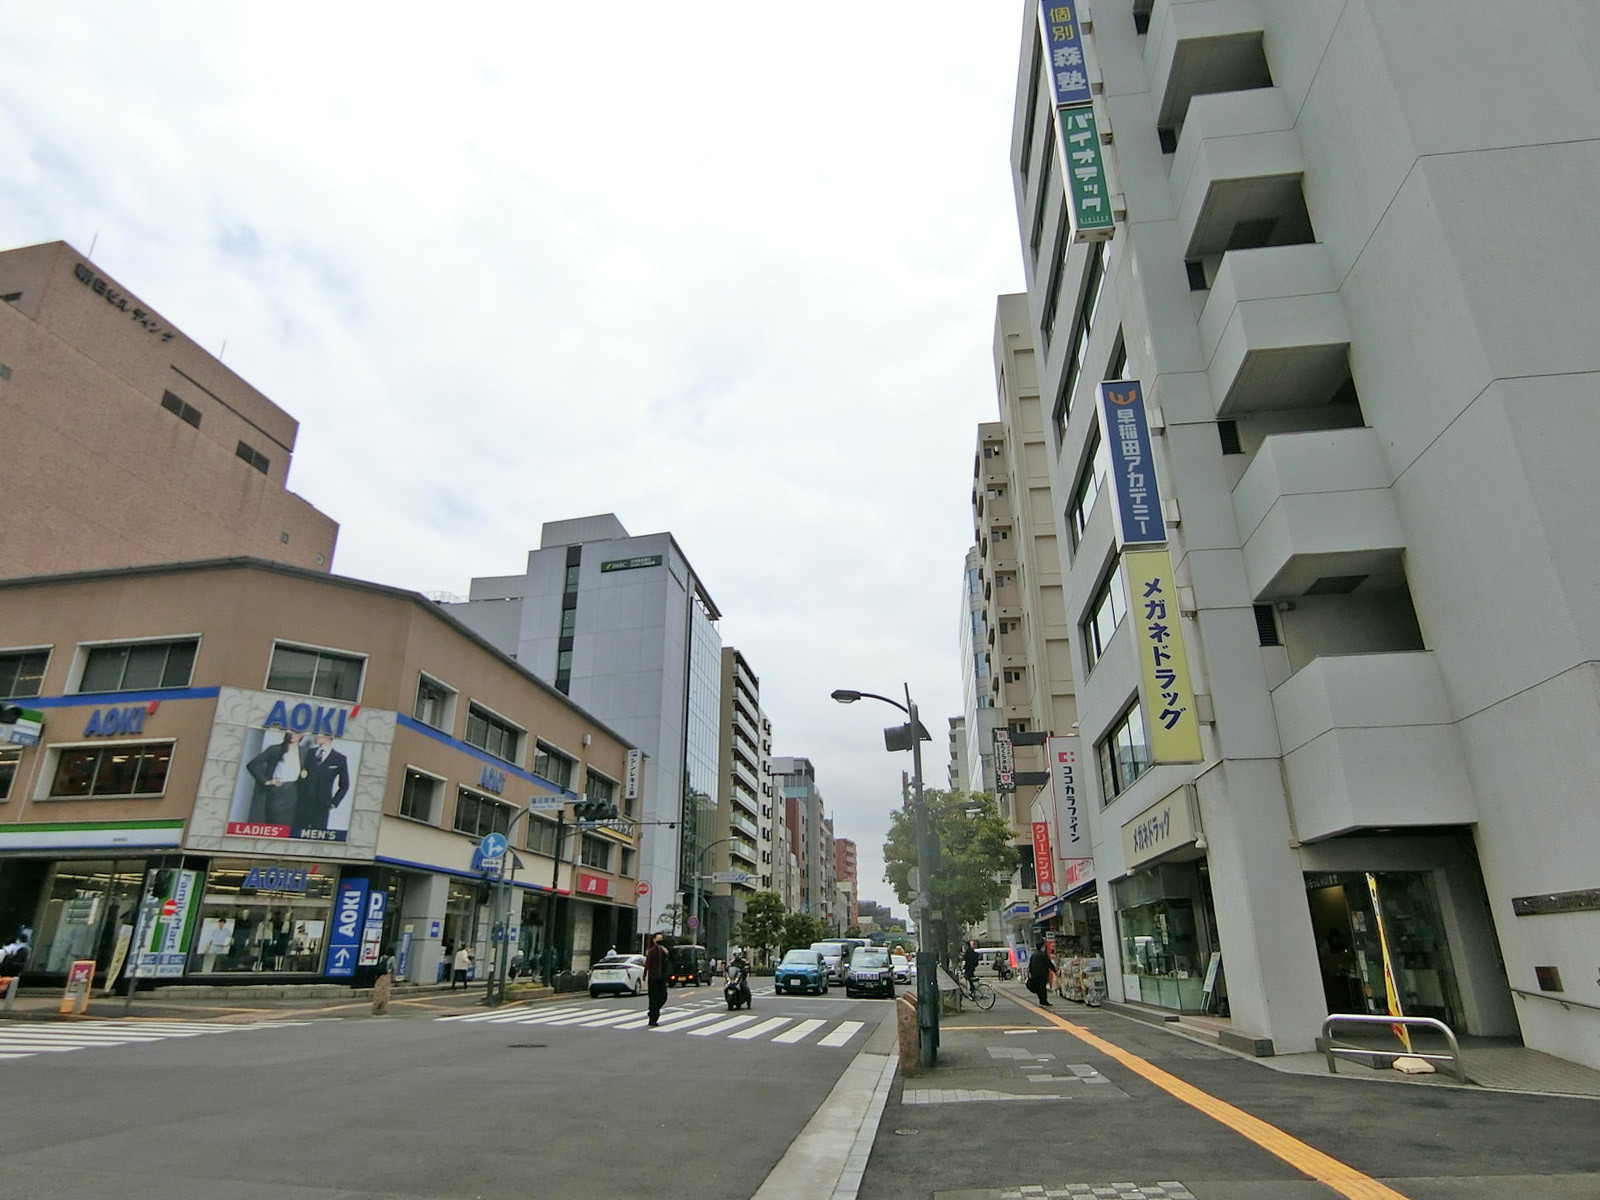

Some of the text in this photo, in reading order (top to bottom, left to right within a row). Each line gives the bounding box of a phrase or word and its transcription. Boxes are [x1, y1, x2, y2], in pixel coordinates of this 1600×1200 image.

[1067, 113, 1101, 213] バイオテック
[1117, 408, 1148, 535] 早稲田アカデミー
[1142, 577, 1188, 731] メガネドラッグ
[83, 706, 146, 737] AOKI
[263, 700, 348, 738] AOKI
[1062, 766, 1080, 843] ココカラファイン
[235, 824, 284, 837] LADIES'
[301, 828, 337, 840] MEN'S
[1035, 823, 1050, 880] クリーニング
[1133, 807, 1171, 853] メガネドラッグ
[242, 866, 307, 892] AOKI
[167, 873, 193, 950] FamilyMart
[338, 890, 361, 938] AOKI
